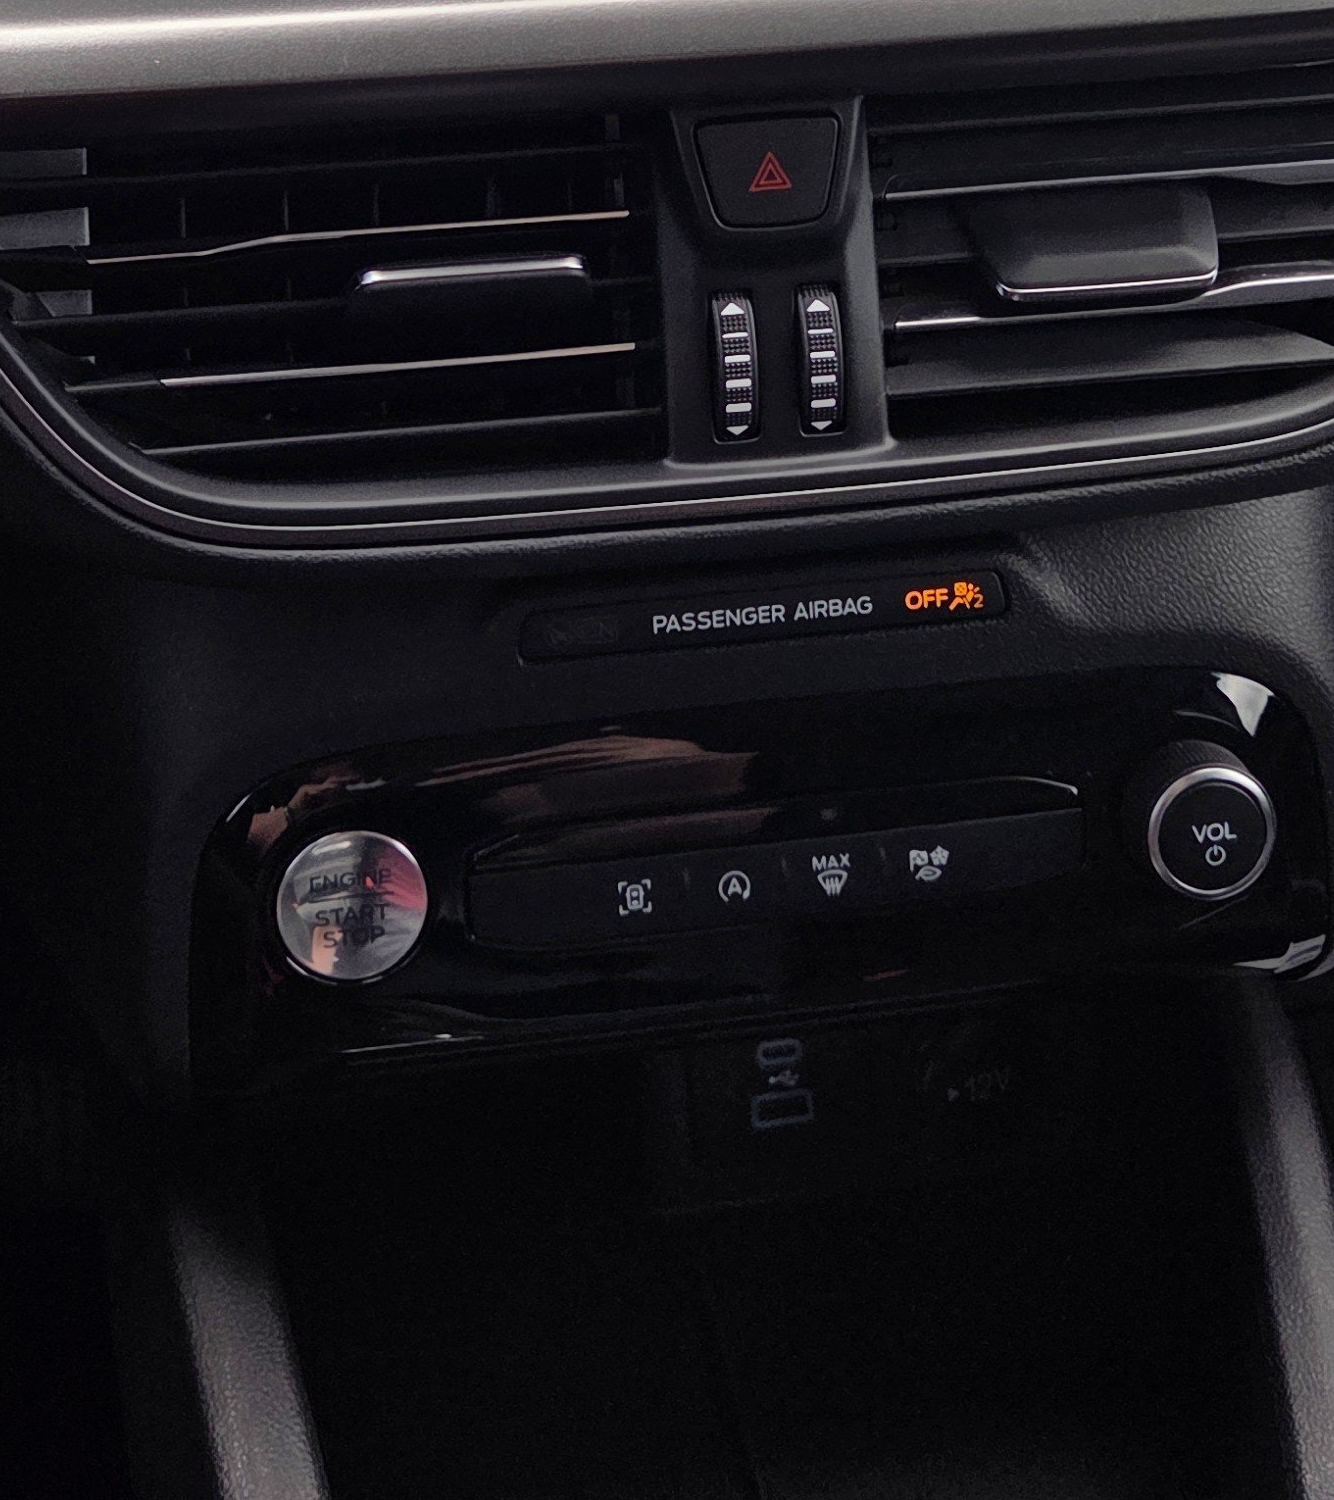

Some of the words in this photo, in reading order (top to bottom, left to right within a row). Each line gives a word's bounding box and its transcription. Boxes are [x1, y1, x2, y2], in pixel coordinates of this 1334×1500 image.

[652, 604, 786, 635] PASSENGER
[793, 595, 874, 622] AIRBAG
[904, 587, 949, 611] OFF
[1191, 820, 1238, 844] VOL
[811, 852, 851, 872] MAX
[308, 867, 392, 895] ENGINE
[314, 903, 391, 927] START
[322, 924, 386, 949] STOP
